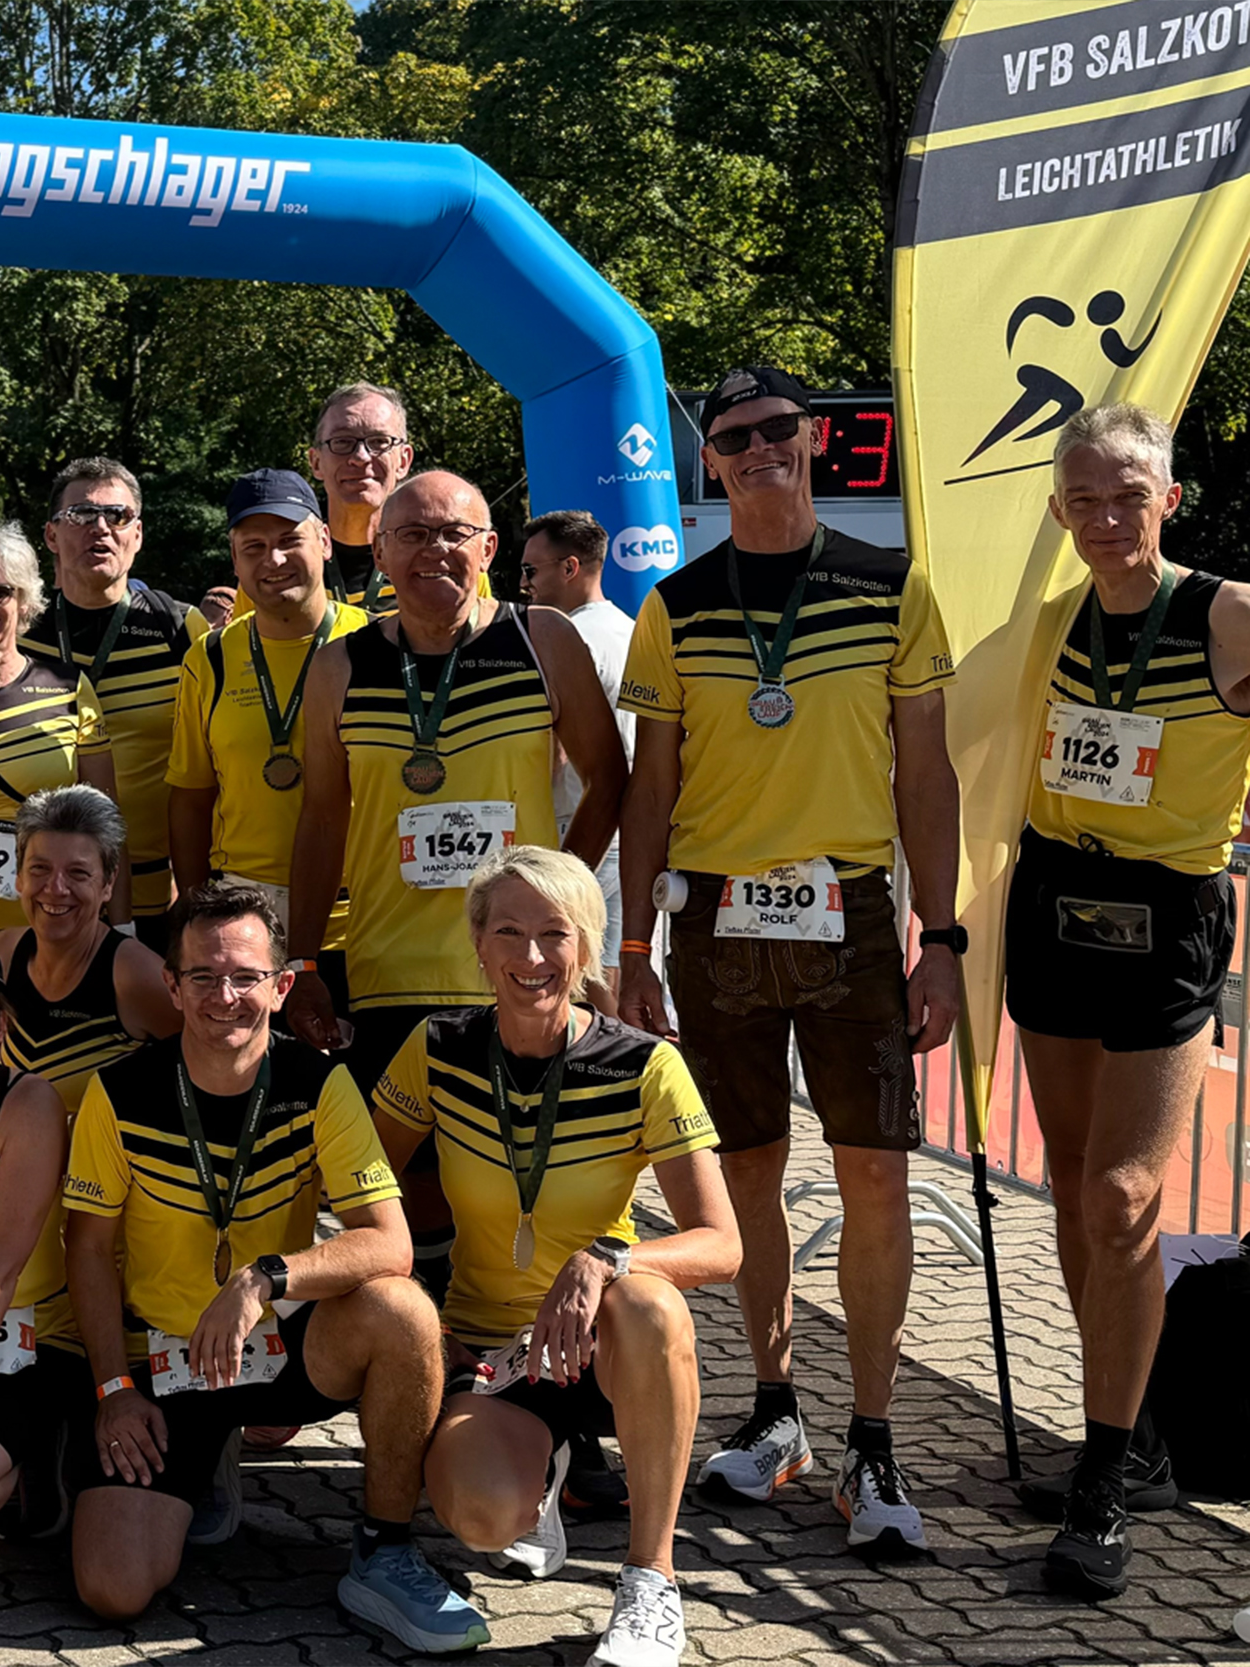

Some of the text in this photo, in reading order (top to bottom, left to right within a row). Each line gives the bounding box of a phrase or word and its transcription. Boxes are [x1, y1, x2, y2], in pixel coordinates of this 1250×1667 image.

[1003, 42, 1074, 95] VFB
[997, 118, 1242, 201] LEICHTATHLETIK
[281, 203, 308, 214] 1924
[597, 469, 672, 486] M-WAVE
[618, 539, 676, 558] KMC
[807, 571, 892, 593] VfB Salzkotten
[1155, 635, 1202, 648] alzkotten
[1062, 737, 1120, 770] 1126
[1061, 767, 1112, 786] MARTIN
[425, 832, 493, 857] 1547
[422, 862, 479, 873] HANS-JOAC
[743, 881, 816, 909] 1330
[759, 912, 798, 924] ROLF
